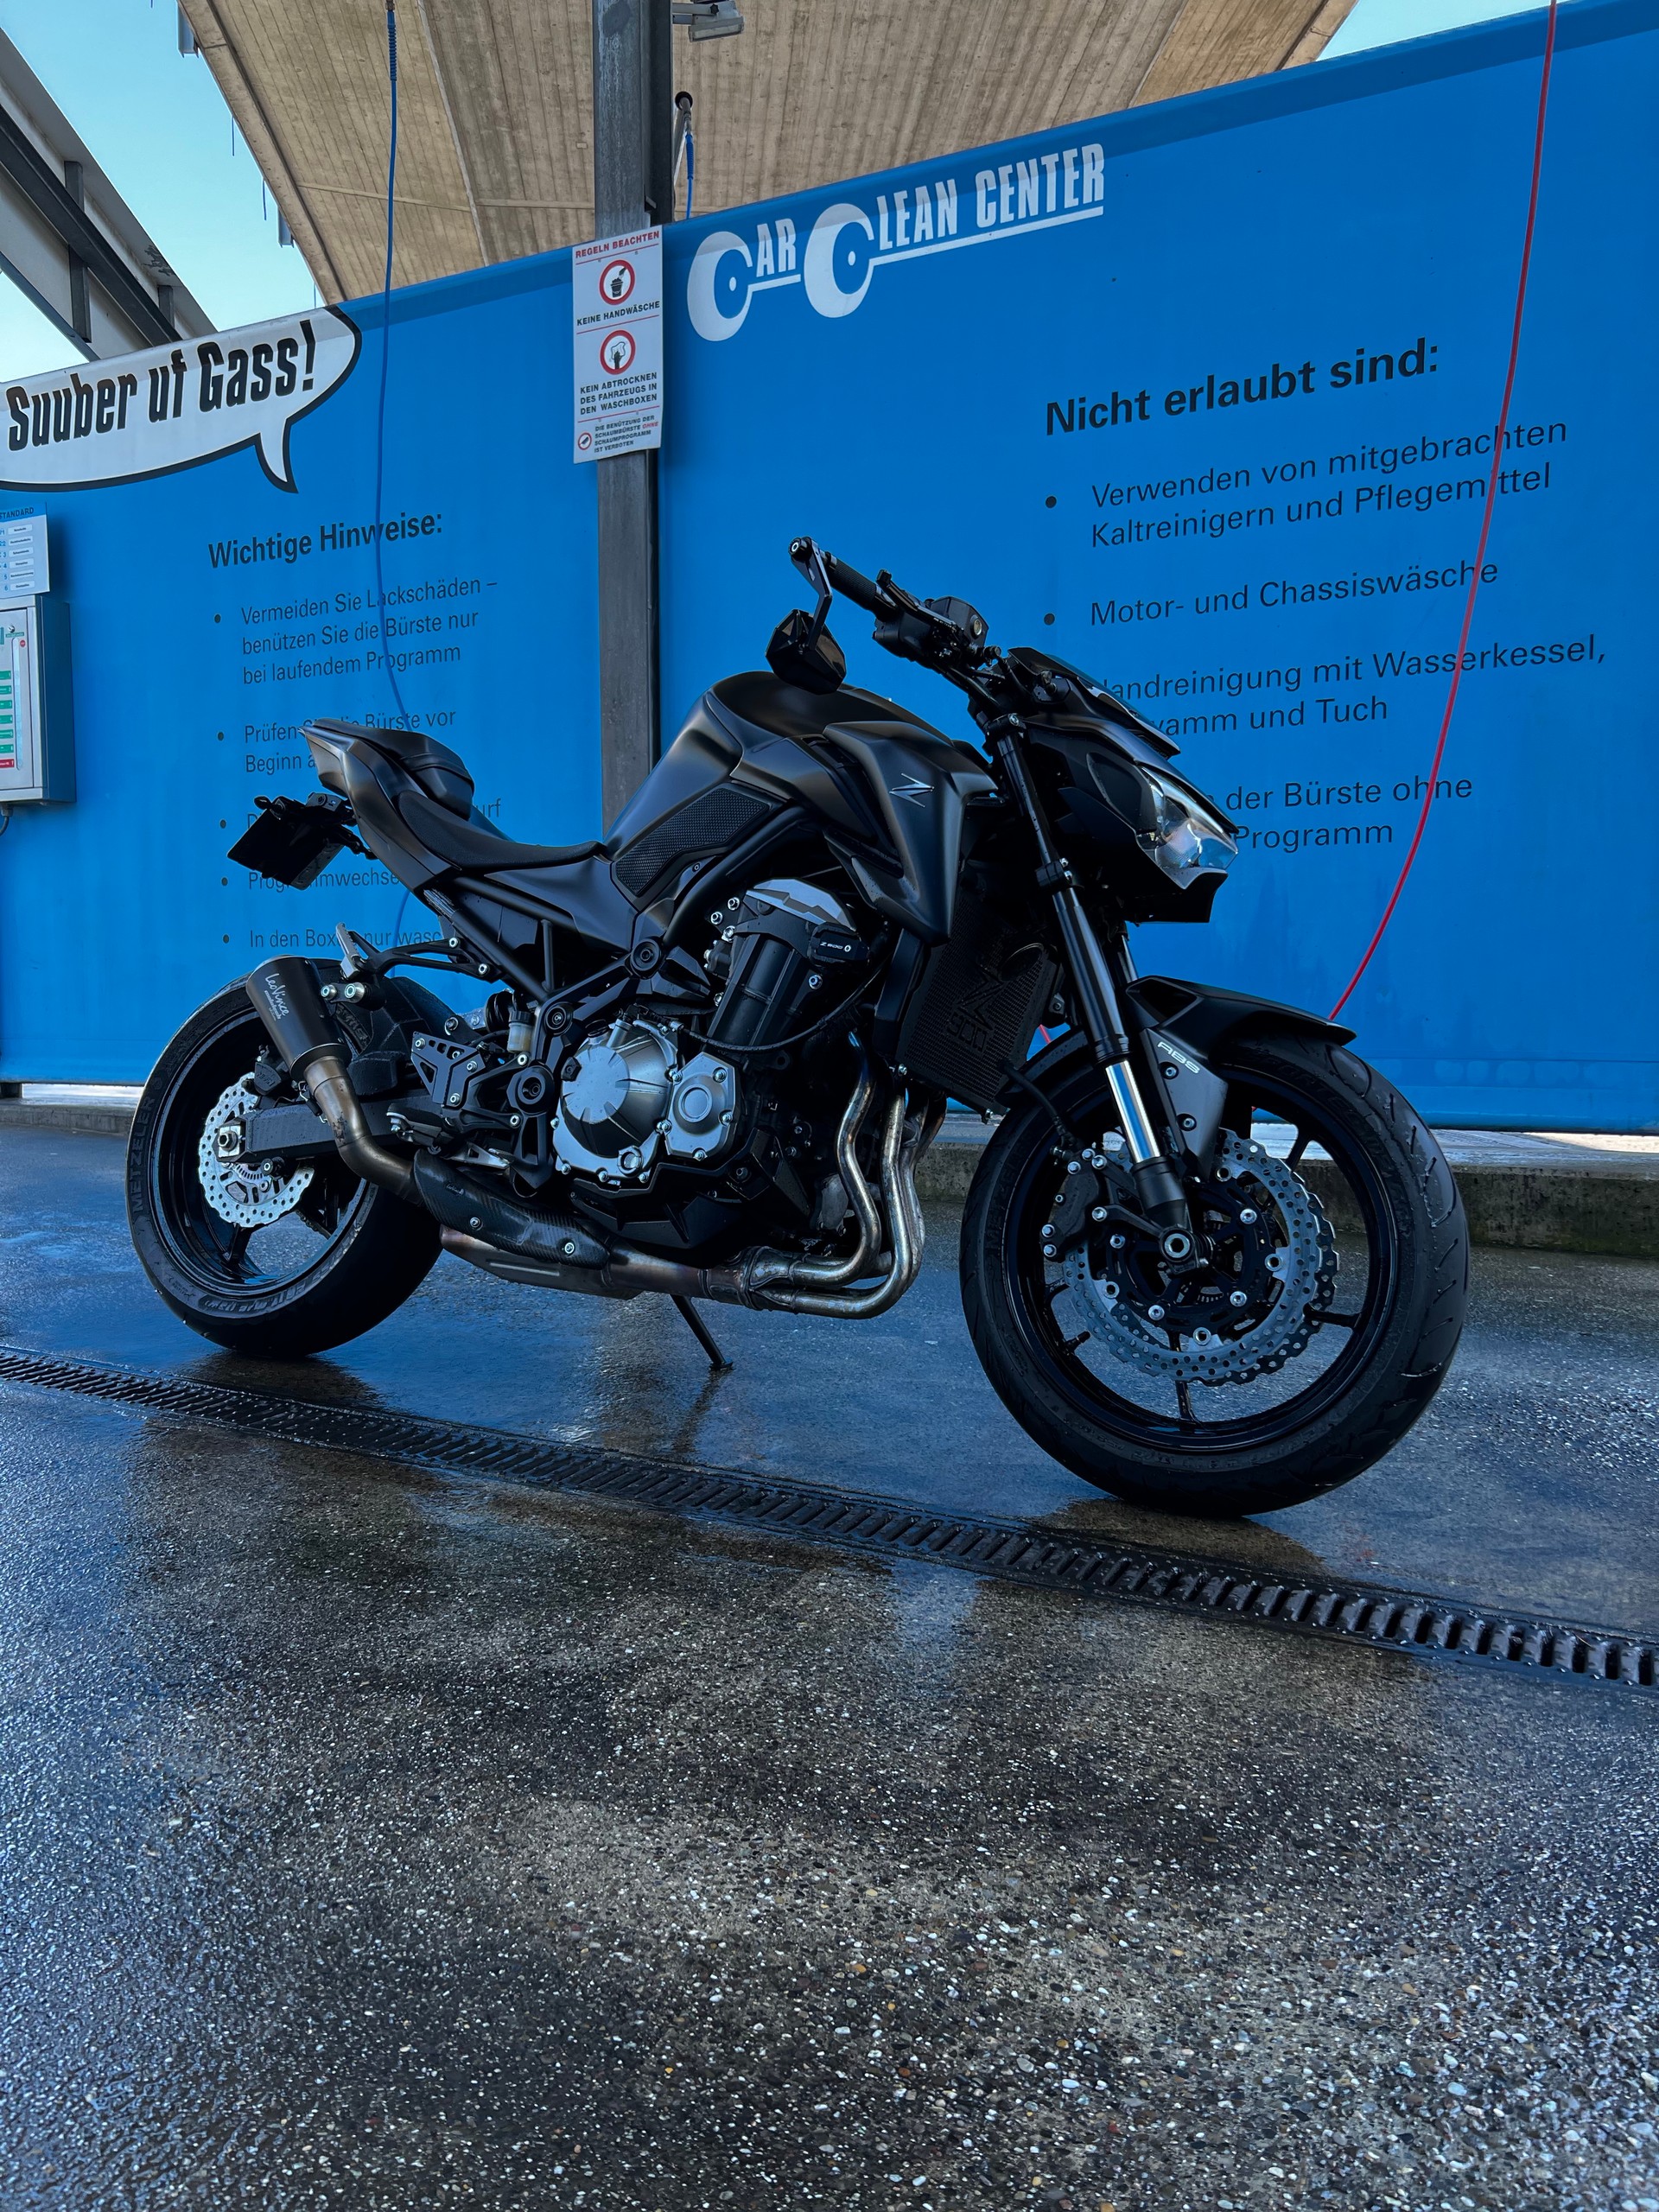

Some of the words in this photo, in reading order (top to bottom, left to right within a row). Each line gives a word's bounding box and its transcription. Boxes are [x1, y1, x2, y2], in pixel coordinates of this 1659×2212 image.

[575, 243, 609, 258] REGELN
[612, 231, 659, 250] BEACHTEN
[687, 219, 796, 341] CAR
[804, 179, 958, 318] CLEAN
[975, 143, 1105, 228] CENTER
[576, 312, 601, 327] KEINE
[603, 301, 660, 321] HANDWÄSCHE
[6, 373, 137, 451] Suuber
[148, 348, 188, 423] uf
[197, 319, 317, 413] Gass!
[580, 384, 599, 395] KEIN
[601, 372, 658, 390] ABTROCKNEN
[580, 395, 596, 405] DES
[598, 385, 646, 402] FAHRZEUGS
[648, 382, 658, 391] IN
[1046, 388, 1151, 435] Nicht
[1163, 360, 1316, 415] erlaubt
[1328, 337, 1440, 390] sind:
[580, 405, 597, 415] DEN
[601, 393, 658, 410] WASCHBOXEN
[594, 424, 641, 439] SCHAUMBÜRSTE
[594, 429, 652, 446] SCHAUMPROGRAMM
[606, 417, 641, 429] BENÜTZUNG
[604, 440, 634, 451] VERBOTEN
[1091, 465, 1251, 509] Verwenden
[1261, 457, 1317, 483] von
[1328, 420, 1567, 474] mitgebrachten
[1091, 504, 1275, 549] Kaltreinigern
[1287, 490, 1344, 524] und
[1355, 461, 1551, 513] Pflegemttel
[208, 532, 312, 569] Wichtige
[320, 512, 443, 551] Hinweise:
[242, 599, 329, 625] Vermeiden
[335, 592, 362, 613] Sie
[1091, 601, 1185, 626] Motor-
[1194, 585, 1249, 615] und
[1260, 560, 1498, 607] Chassiswäsche
[243, 629, 316, 655] benützen
[321, 625, 348, 645] Sie
[354, 621, 378, 642] die
[385, 614, 442, 638] Bürste
[448, 612, 479, 630] nur
[243, 664, 266, 685] bei
[271, 655, 361, 682] laufendem
[1102, 665, 1301, 700] andreinigung
[1313, 655, 1363, 685] mit
[1372, 633, 1606, 679] Wasserkessel,
[245, 721, 299, 744] Prüfen
[425, 710, 456, 727] vor
[1249, 702, 1306, 730] und
[1315, 696, 1388, 724] Tuch
[245, 753, 302, 775] Beginn
[1226, 785, 1273, 813] der
[1284, 779, 1382, 809] Bürste
[1393, 775, 1473, 803] ohne
[1233, 822, 1394, 854] Programm
[250, 930, 267, 947] In
[270, 929, 300, 947] den
[365, 931, 392, 946] nur
[1157, 1041, 1200, 1074] ABS
[130, 1096, 155, 1213] METZELER
